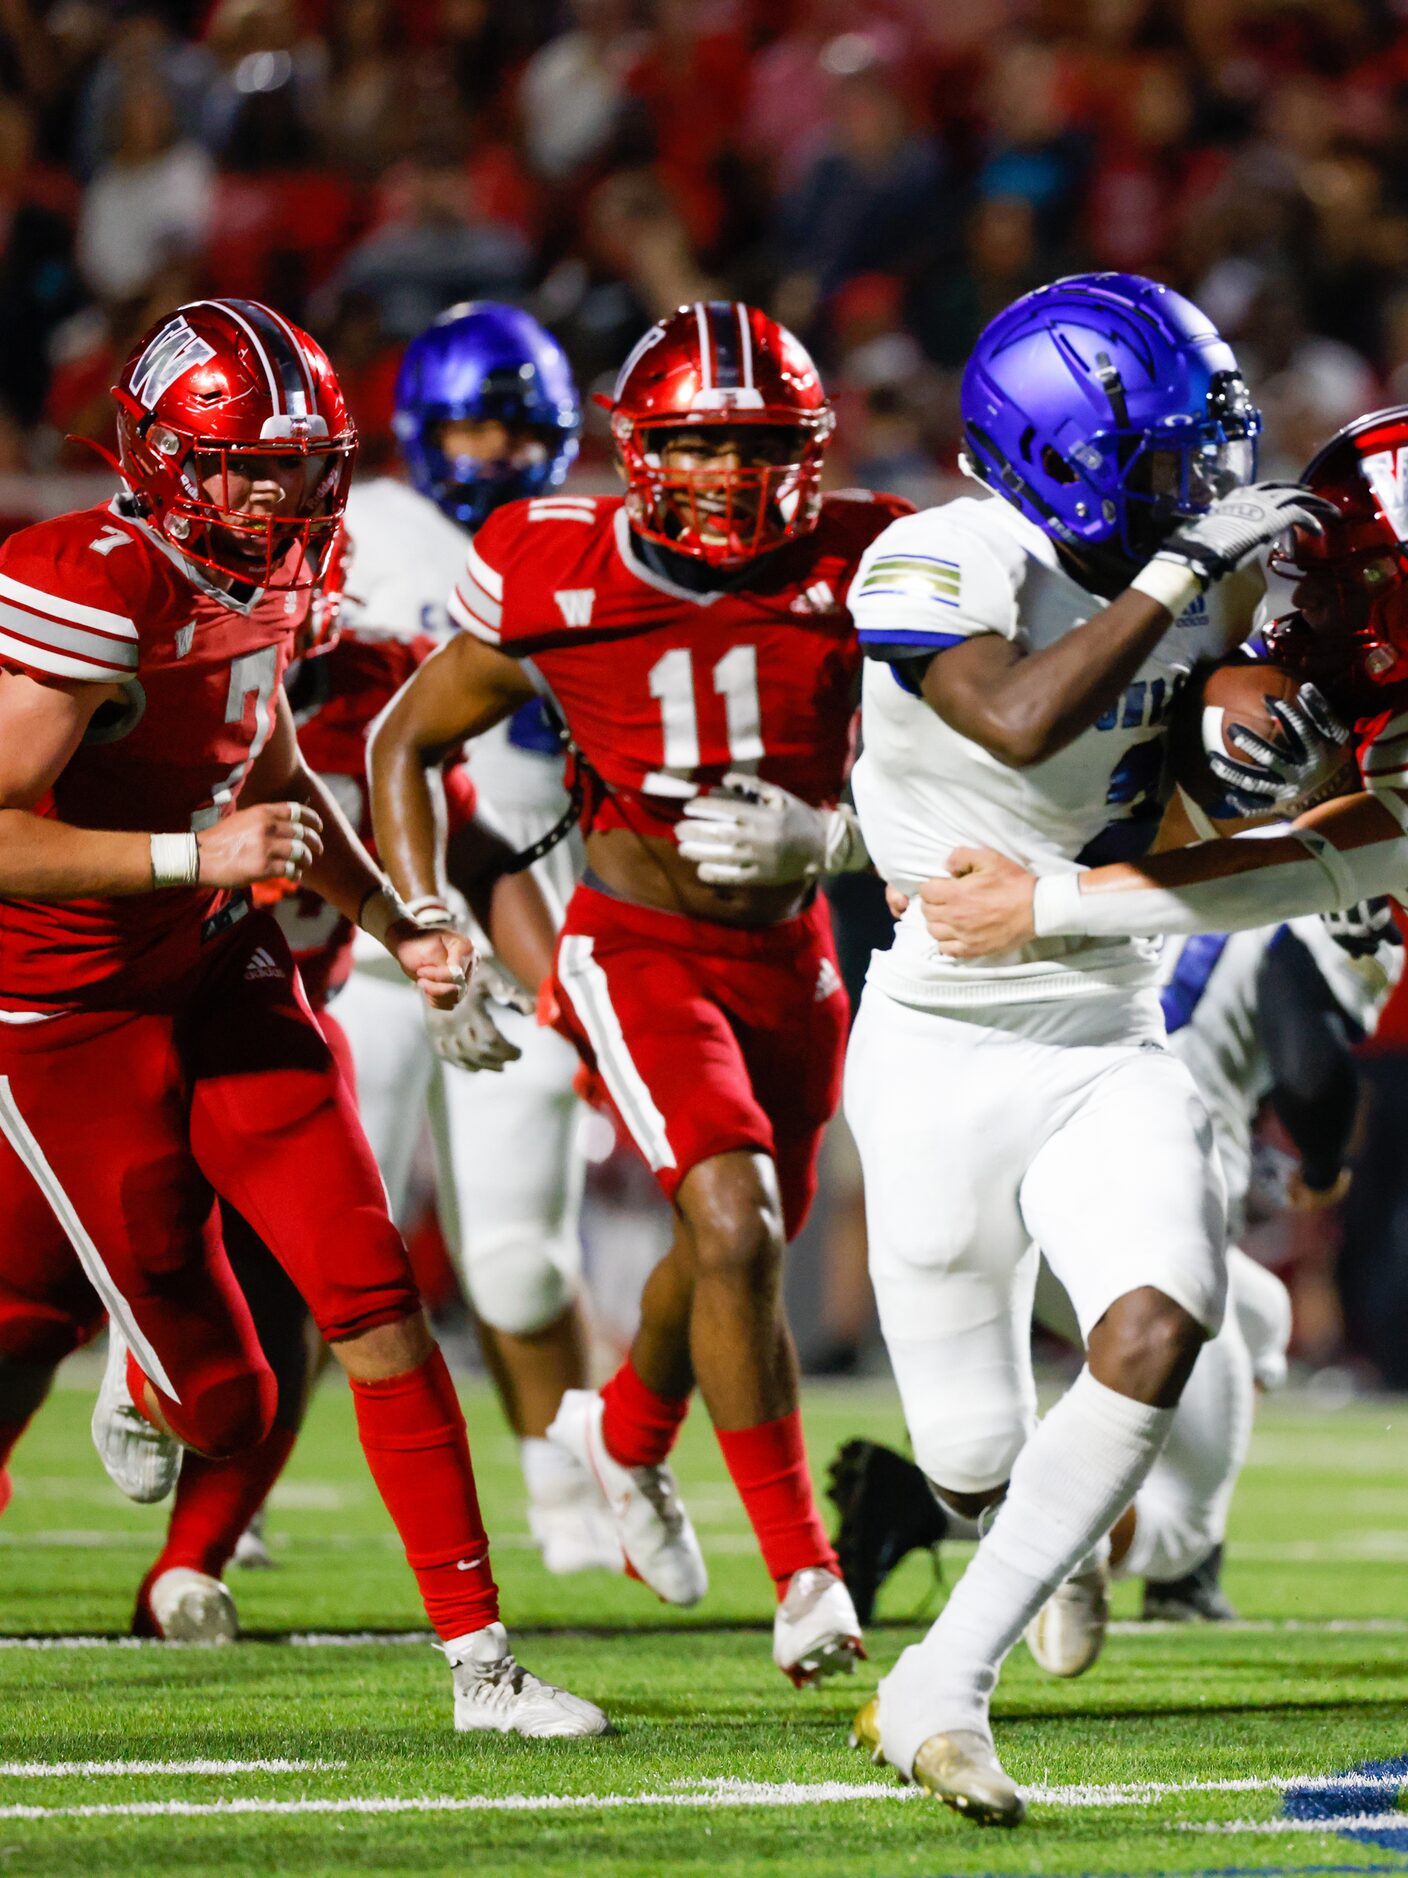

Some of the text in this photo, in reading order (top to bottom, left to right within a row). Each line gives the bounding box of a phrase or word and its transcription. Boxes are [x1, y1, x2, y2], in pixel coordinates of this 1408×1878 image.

[128, 314, 218, 411] W
[89, 525, 134, 556] 7
[554, 588, 595, 627] W
[641, 644, 766, 798] 11
